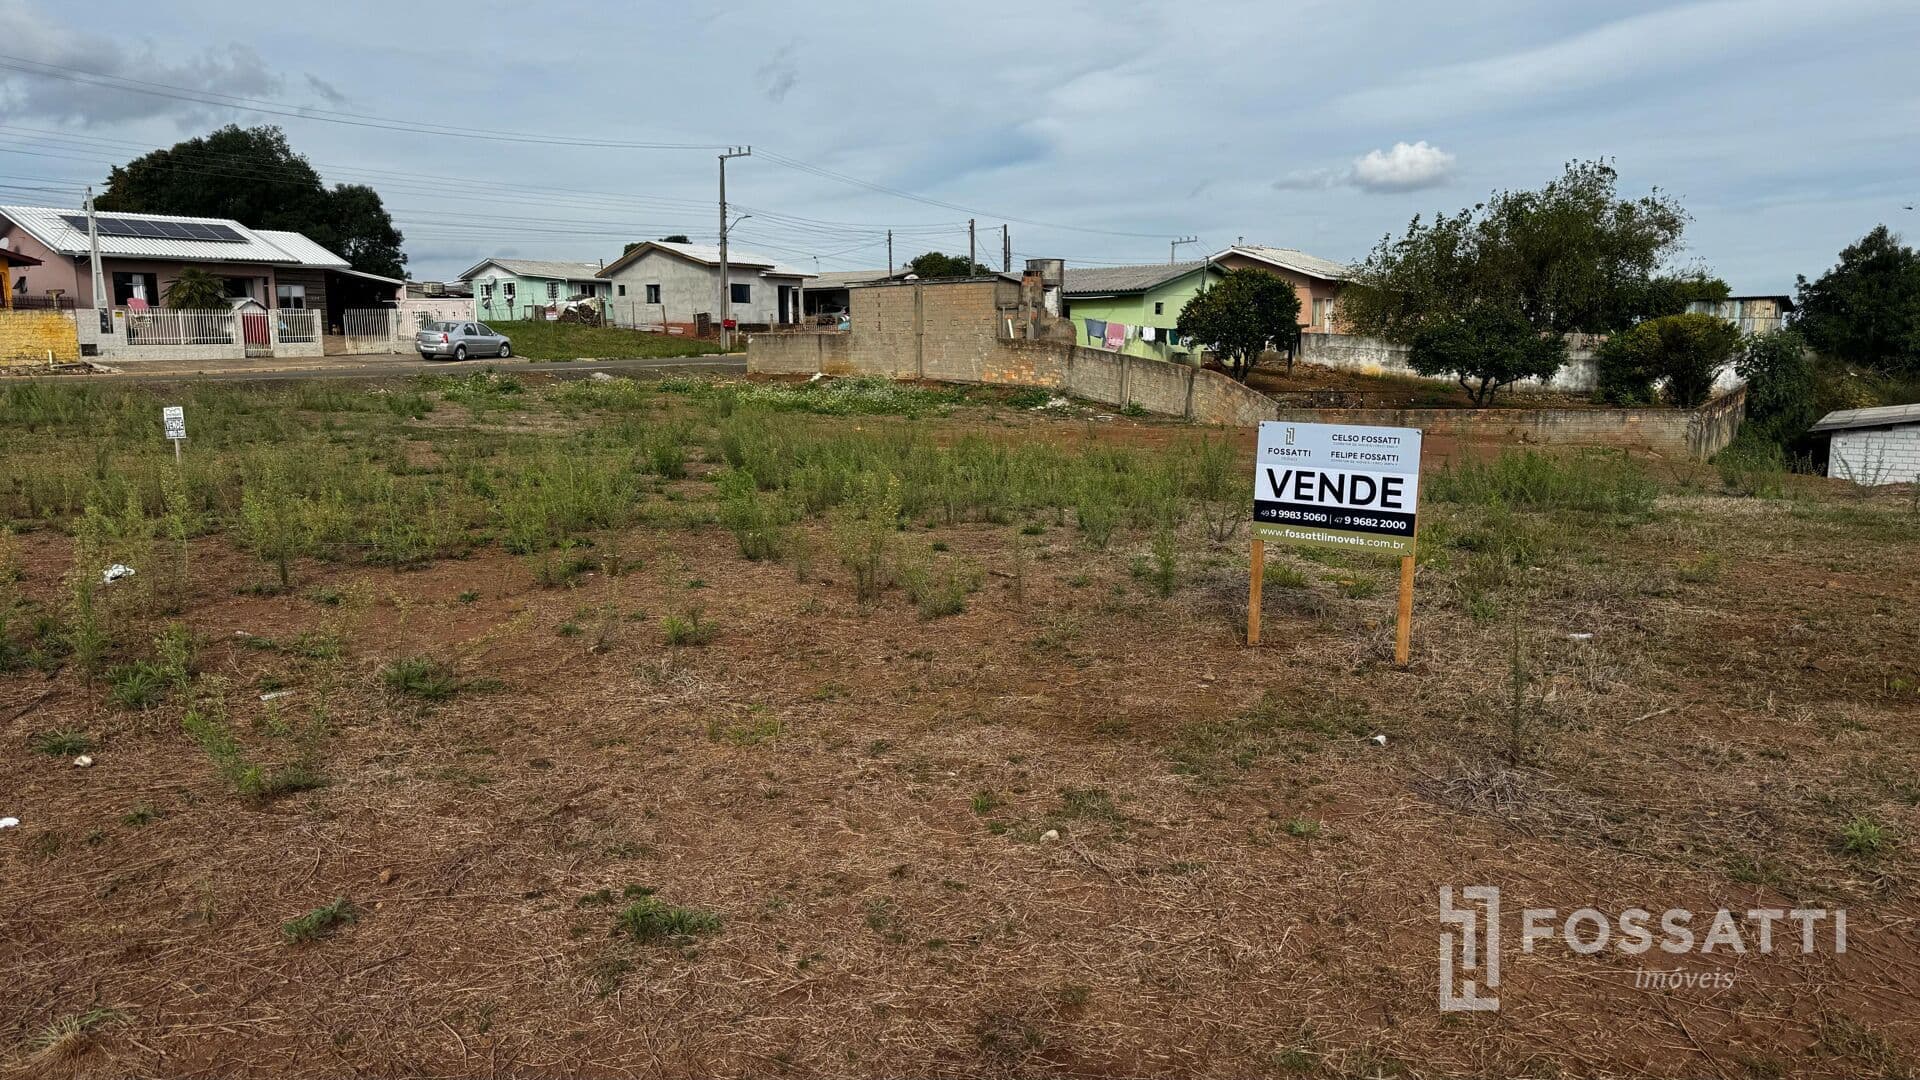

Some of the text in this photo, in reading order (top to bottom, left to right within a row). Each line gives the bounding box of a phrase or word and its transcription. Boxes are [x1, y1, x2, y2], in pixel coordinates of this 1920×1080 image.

[1332, 434, 1400, 445] CELSO FOSSATTI
[1267, 447, 1311, 457] FOSSATTI
[1331, 451, 1399, 462] FELIPE FOSSATTI
[1266, 468, 1404, 509] VENDE
[1270, 509, 1277, 517] 9
[1278, 510, 1302, 520] 9983
[1303, 512, 1327, 522] 5060
[1344, 516, 1351, 524] 9
[1353, 516, 1378, 527] 9682
[1380, 519, 1407, 530] 2000
[1259, 527, 1405, 550] www.fossattiimoveis.com.br
